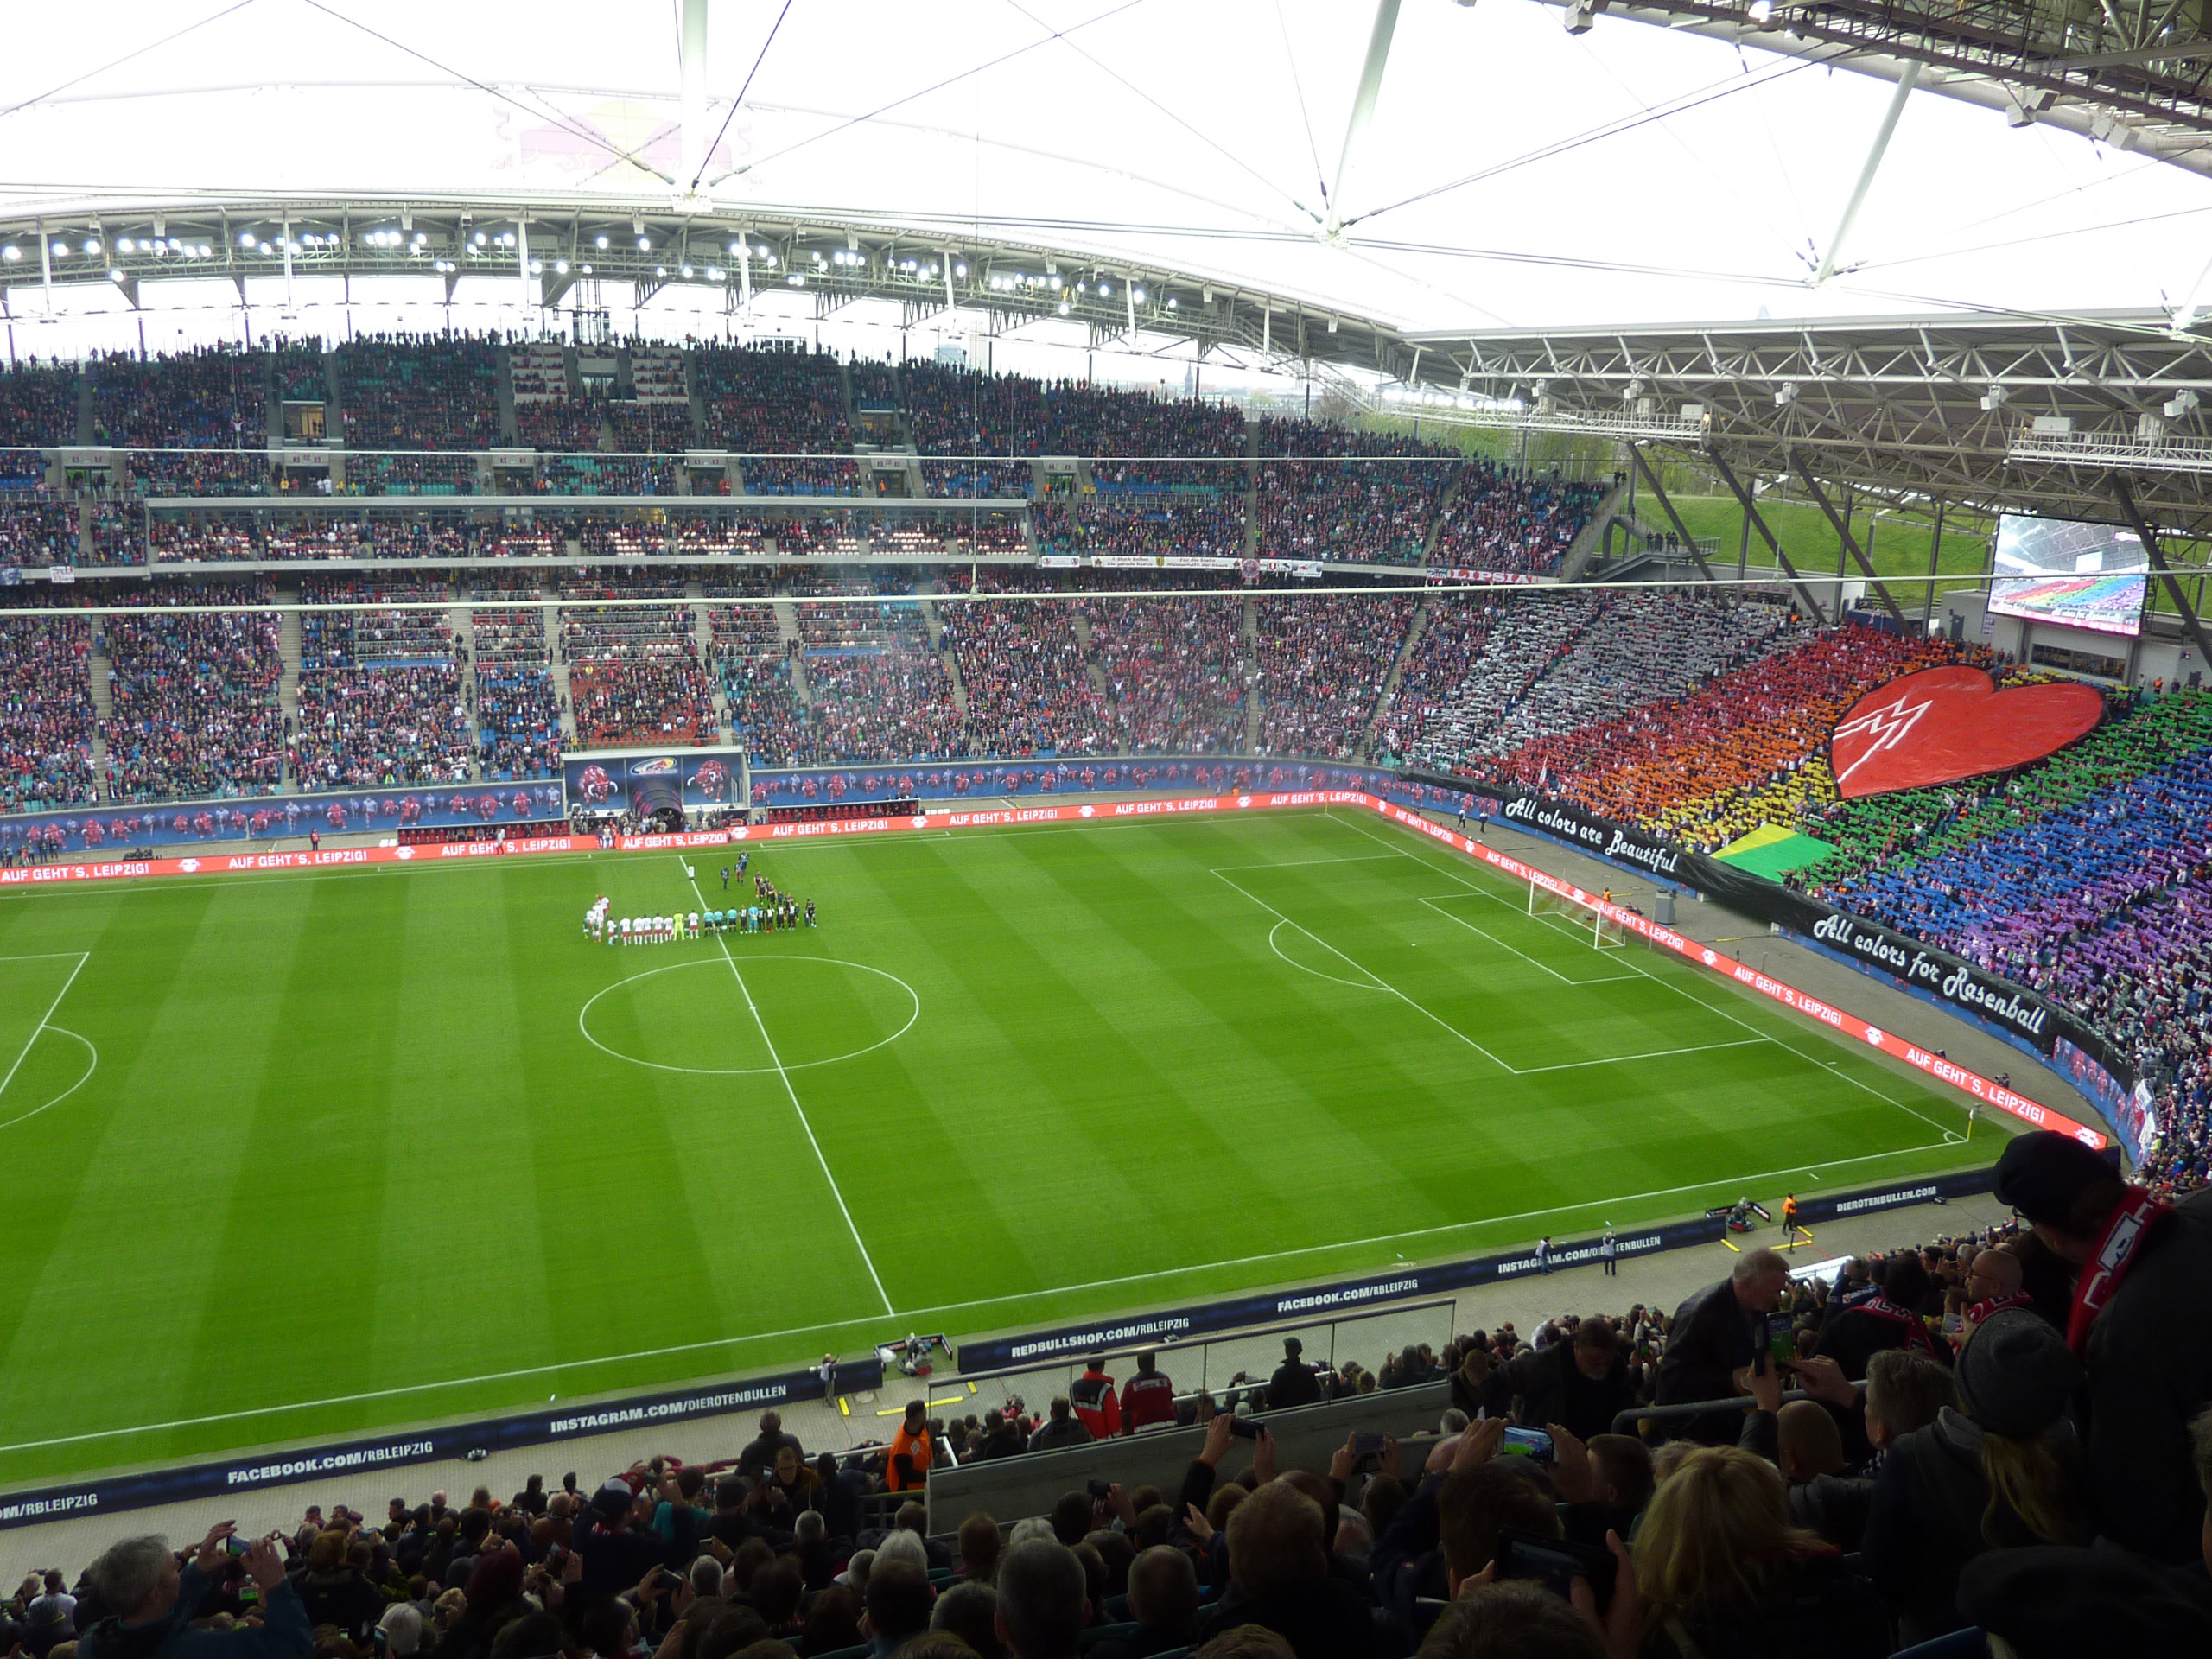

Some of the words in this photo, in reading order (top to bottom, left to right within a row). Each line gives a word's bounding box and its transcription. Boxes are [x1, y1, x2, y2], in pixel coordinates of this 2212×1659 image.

[1453, 569, 1529, 583] LIPSIA
[1115, 804, 1135, 815] AUF
[1179, 799, 1217, 810] LEIPZIG!
[1270, 795, 1288, 805] AUF
[1330, 792, 1366, 804] LEIPZIG!
[772, 825, 794, 836] AUF
[845, 819, 887, 832] LEIPZIG!
[949, 814, 970, 825] AUF
[1017, 809, 1058, 821] LEIPZIG!
[442, 844, 466, 856] AUF
[522, 838, 571, 852] LEIPZIG!
[623, 837, 644, 849] AUF
[688, 833, 727, 845] LEIPZIG!
[1505, 797, 1534, 818] All
[1537, 810, 1576, 834] colors
[1580, 828, 1603, 845] are
[1605, 830, 1678, 872] Beautiful
[1, 869, 28, 882] AUF
[93, 863, 149, 877] LEIPZIG!
[228, 856, 254, 869] AUF
[315, 850, 367, 864] LEIPZIG!
[1486, 852, 1499, 862] AUF
[1529, 870, 1557, 889] LEIPZIG!
[1599, 902, 1615, 917] AUF
[1649, 925, 1684, 949] LEIPZIG!
[1814, 914, 1853, 944] All
[1854, 934, 1906, 965] colors
[1907, 954, 1939, 983] for
[1942, 966, 2048, 1033] Rasenball
[1734, 965, 1754, 981] AUF
[1797, 998, 1842, 1025] LEIPZIG!
[1906, 1048, 1931, 1067] AUF
[1988, 1084, 2045, 1123] LEIPZIG!
[1837, 1185, 1936, 1212] DIEROTENBULLEN.COM
[1277, 1279, 1418, 1312] FACEBOOK.COM/RBLEIPZIG
[1011, 1318, 1189, 1357] REDBULLSHOP.COM/RBLEIPZIG
[550, 1385, 787, 1433] INSTAGRAM.COM/DIEROTENBULLEN
[228, 1441, 432, 1484] FACEBOOK.COM/RBLEIPZIG
